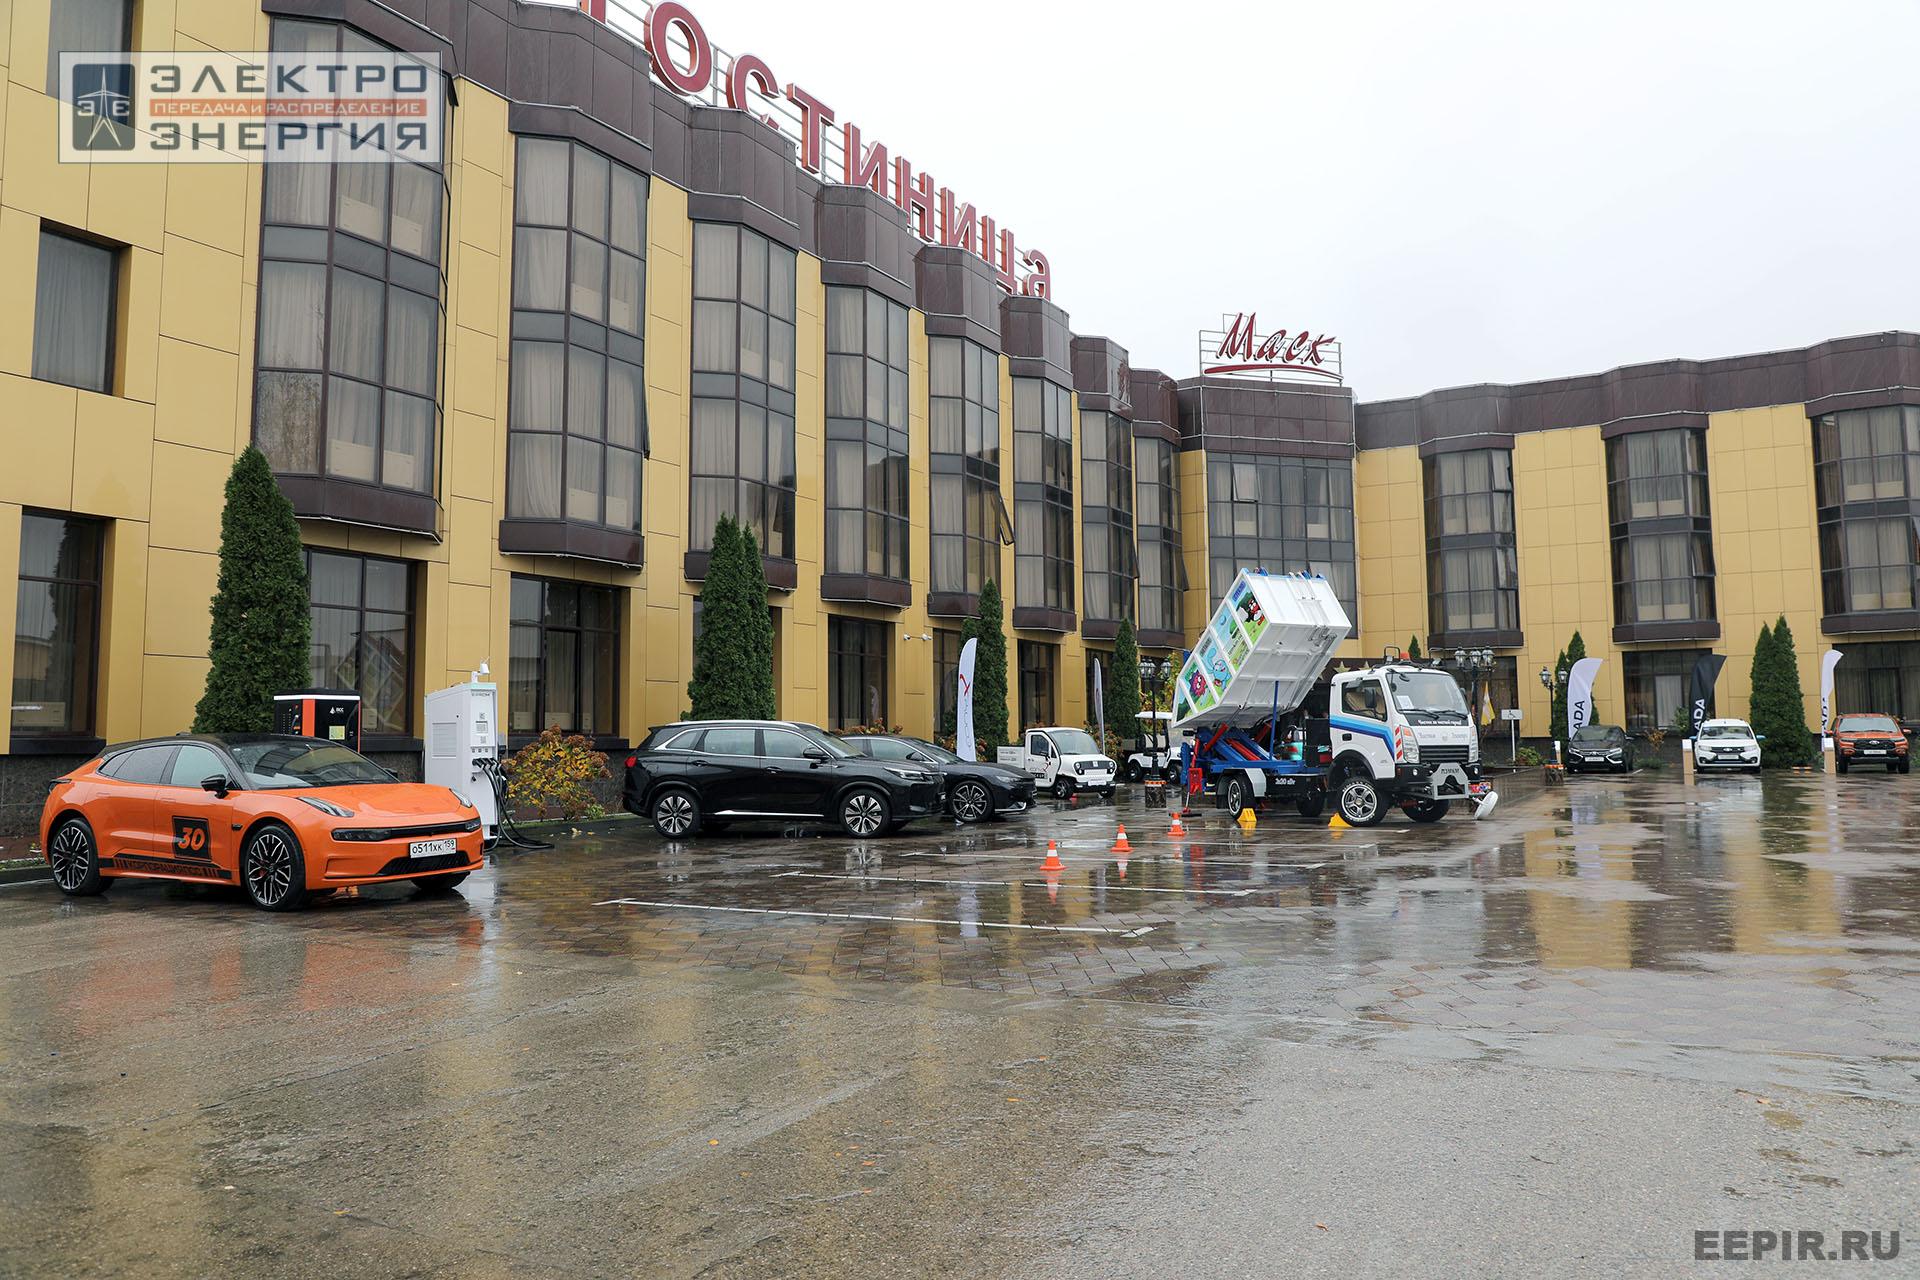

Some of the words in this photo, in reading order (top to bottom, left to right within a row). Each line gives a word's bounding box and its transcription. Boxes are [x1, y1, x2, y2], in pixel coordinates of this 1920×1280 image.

[1573, 700, 1585, 731] ADA
[1694, 699, 1705, 731] ADA
[177, 827, 206, 851] 30
[444, 839, 455, 848] 159
